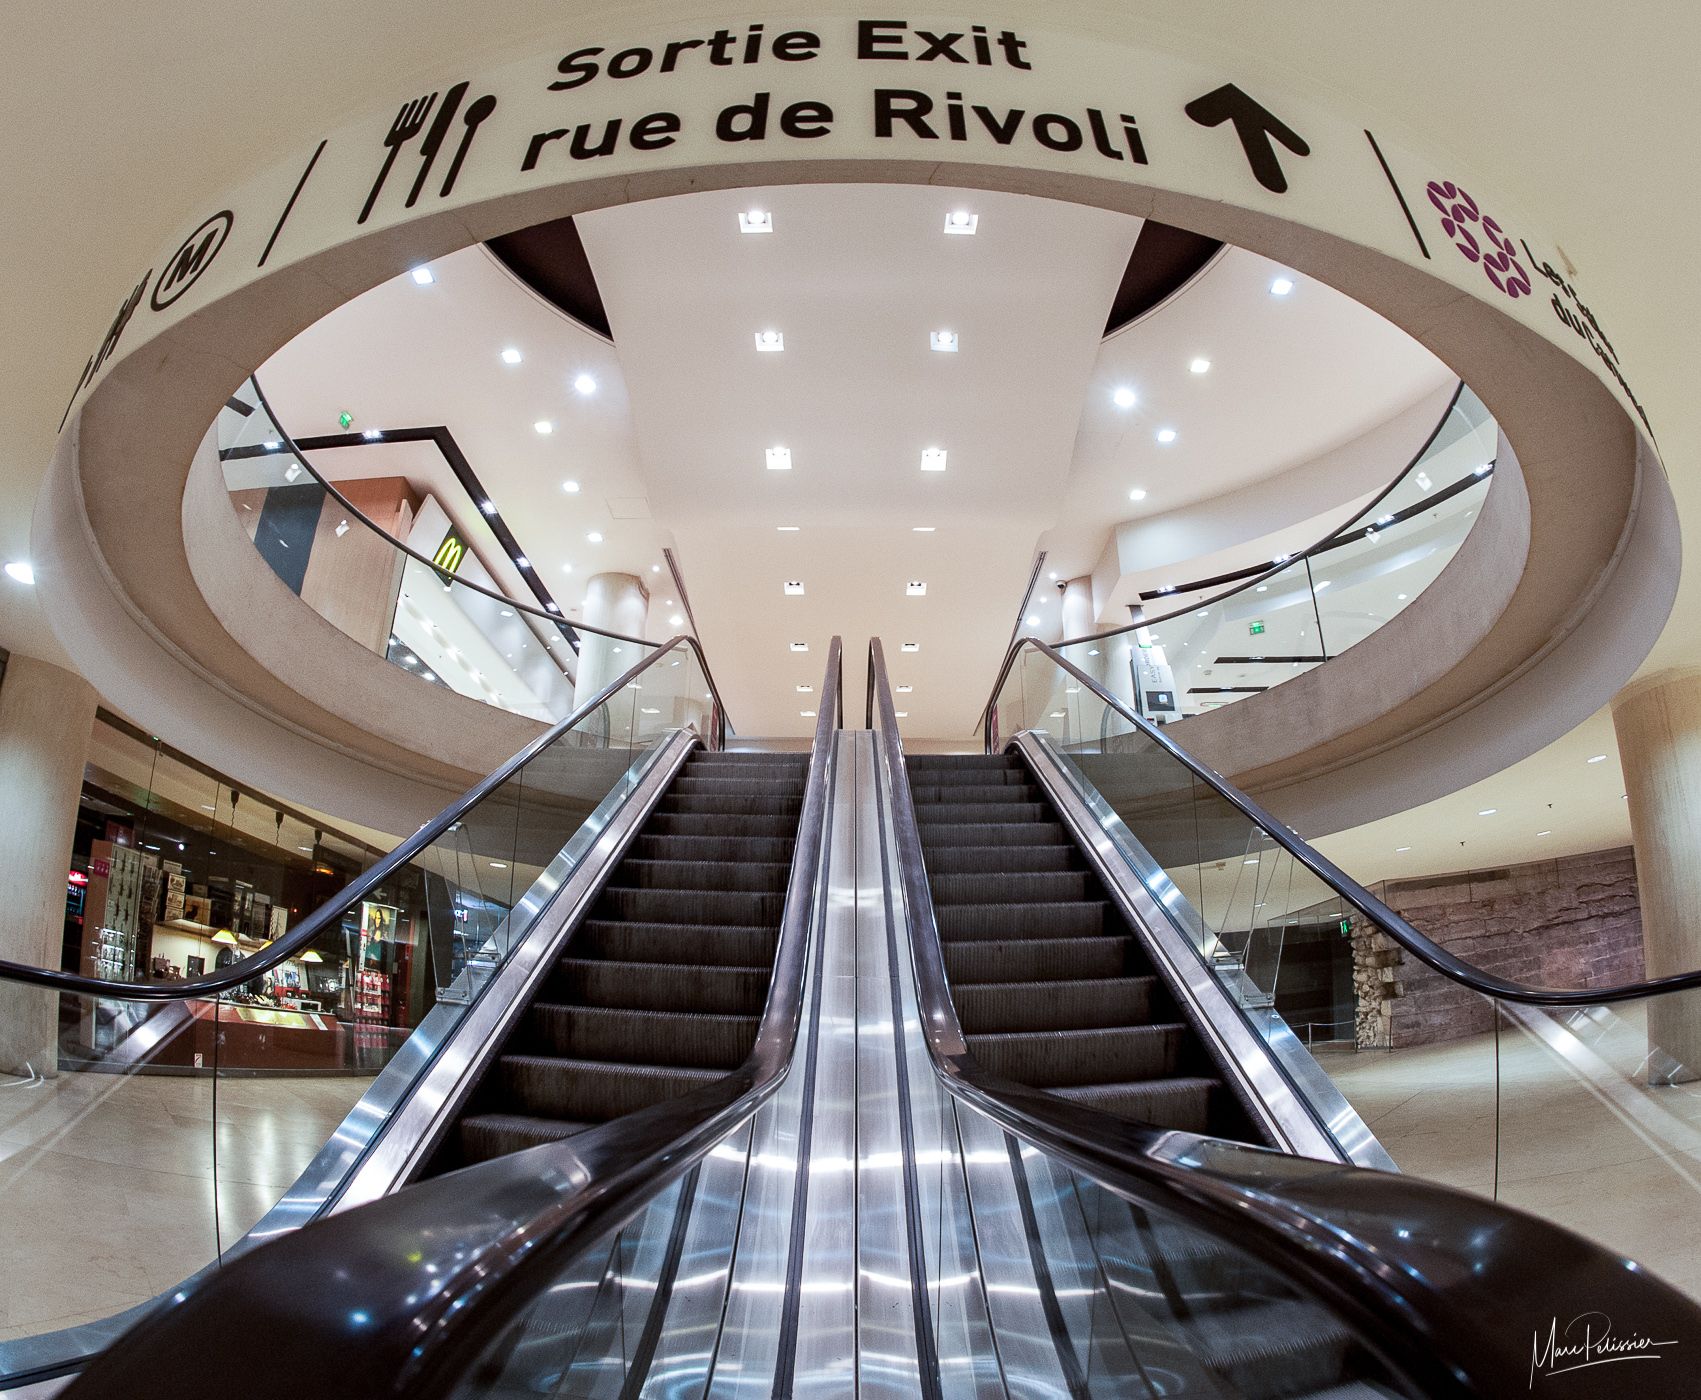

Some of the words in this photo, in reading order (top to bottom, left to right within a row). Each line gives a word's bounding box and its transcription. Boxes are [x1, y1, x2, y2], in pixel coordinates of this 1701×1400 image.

[546, 23, 822, 92] Sortie
[857, 19, 1033, 72] Exit
[520, 111, 682, 173] rue
[715, 91, 835, 143] de
[873, 88, 1150, 166] Rivoli
[162, 227, 220, 293] M
[1550, 292, 1586, 340] du
